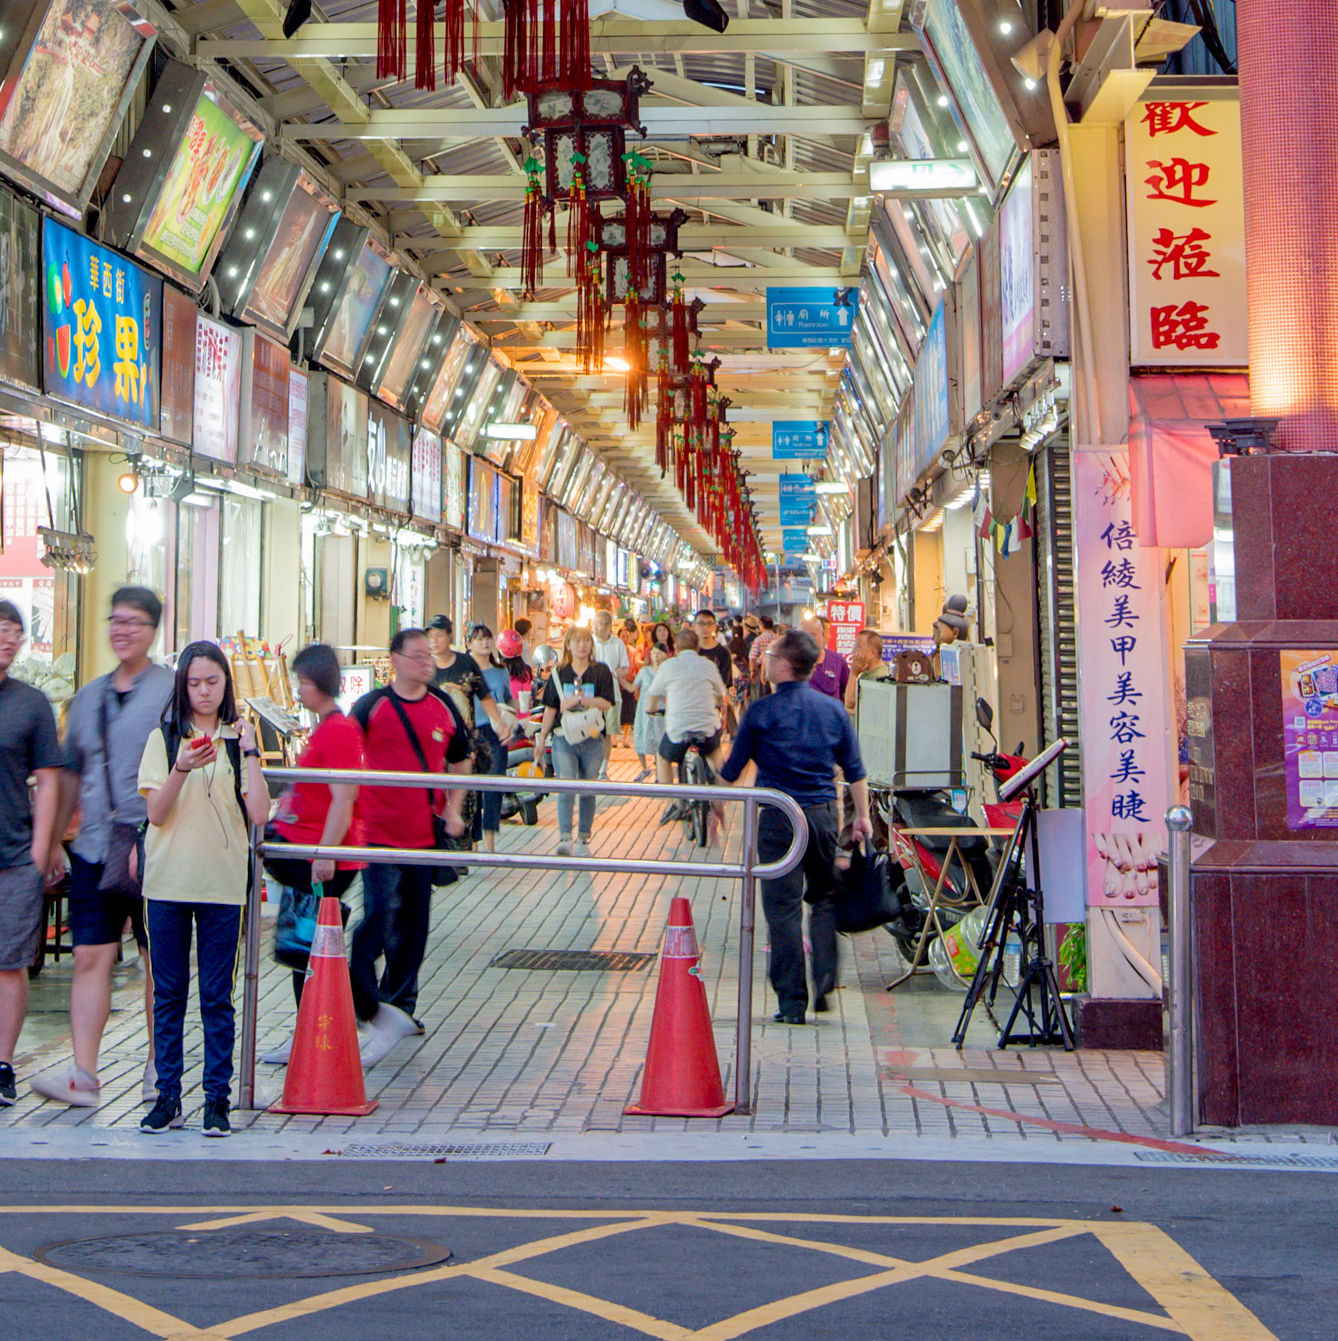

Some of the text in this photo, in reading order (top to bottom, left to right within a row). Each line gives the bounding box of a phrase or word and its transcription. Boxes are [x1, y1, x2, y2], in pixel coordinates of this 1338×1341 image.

[90, 255, 125, 304] 華西街
[1140, 101, 1221, 350] 歡迎蒞臨
[830, 604, 863, 622] 特價
[1099, 520, 1152, 823] 倍綾美甲美容美睫
